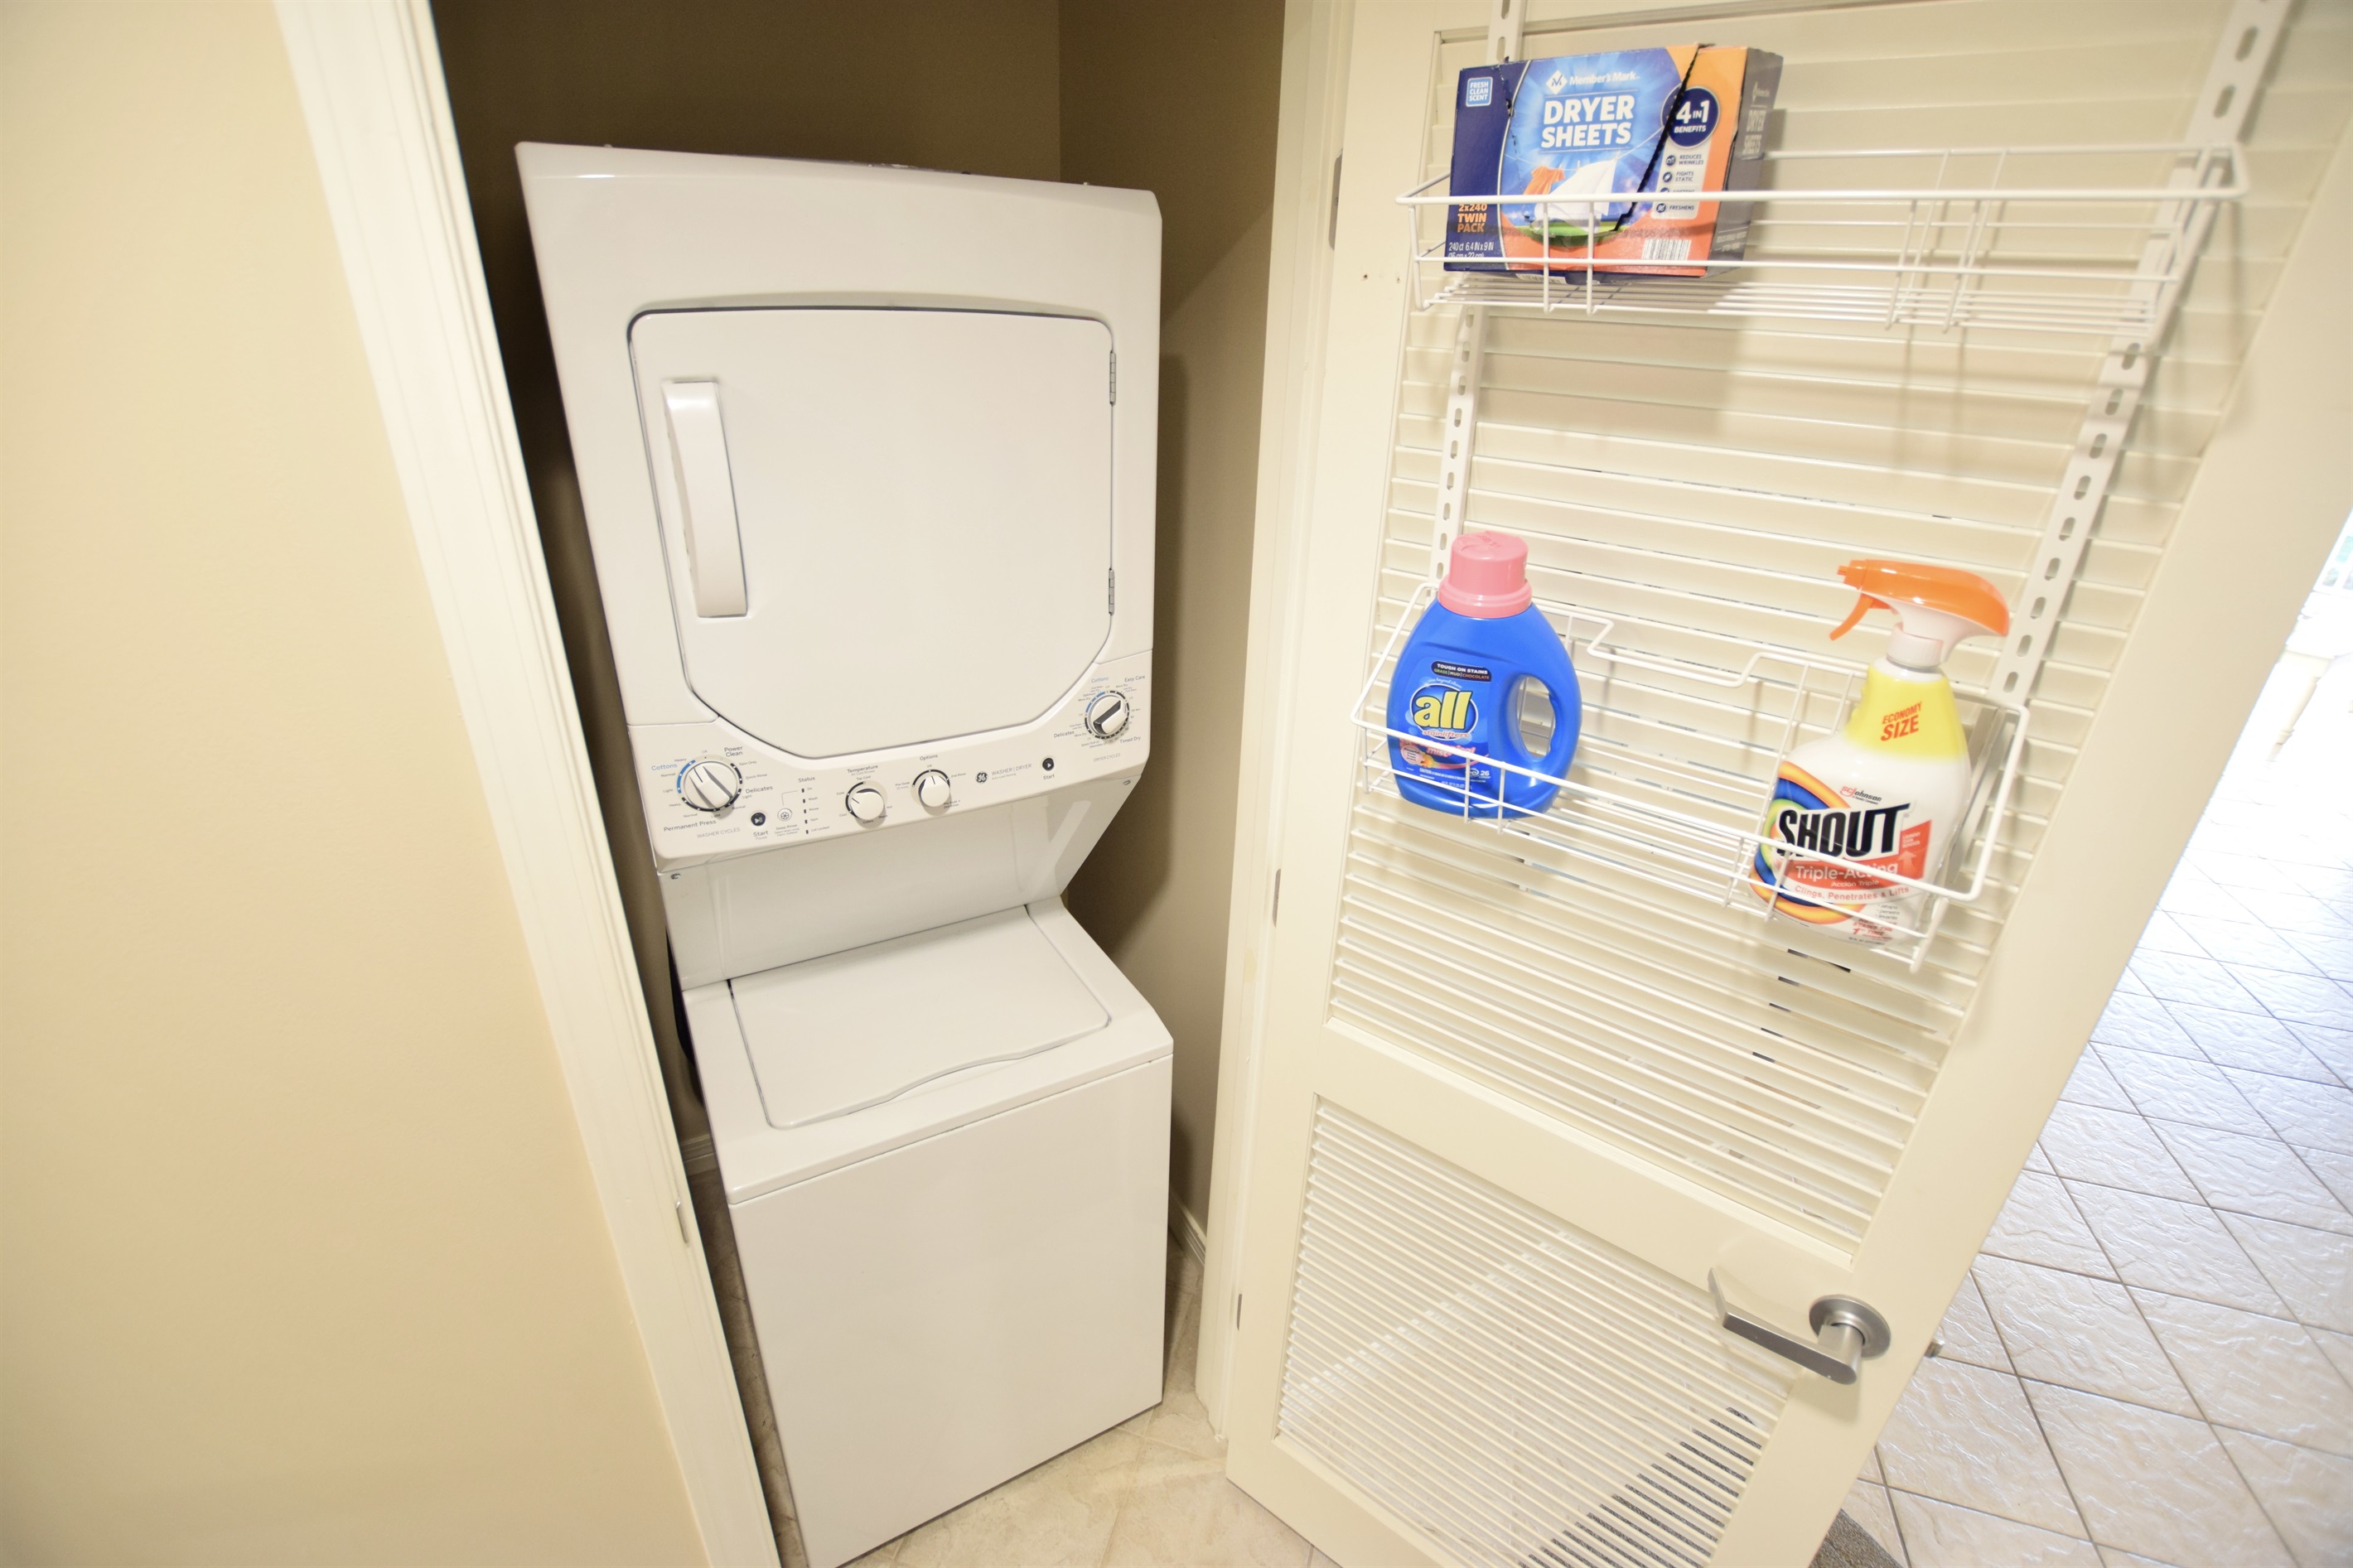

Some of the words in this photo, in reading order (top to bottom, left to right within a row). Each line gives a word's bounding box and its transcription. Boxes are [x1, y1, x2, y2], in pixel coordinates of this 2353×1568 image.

[1569, 73, 1611, 85] Member's
[1613, 71, 1636, 81] Mark
[1544, 95, 1636, 124] DRYER
[1676, 101, 1692, 124] 4
[1693, 110, 1702, 118] IN
[1700, 100, 1710, 123] 1
[1541, 123, 1631, 148] SHEETS
[1674, 125, 1707, 133] BENEFITS
[1458, 203, 1487, 212] 2x240
[1457, 213, 1487, 223] TWIN
[1457, 223, 1486, 233] PACK
[1413, 691, 1472, 730] all
[1882, 702, 1922, 725] ECONOMY
[1423, 730, 1469, 739] stainlifters
[1881, 714, 1919, 741] SIZE
[848, 765, 878, 774] Temperature
[992, 767, 1012, 775] WASHER
[746, 785, 773, 794] Delicates
[664, 823, 698, 832] Permanent
[1776, 803, 1911, 858] SHOUT
[1795, 863, 1898, 882] Triple-Acing
[1828, 892, 1877, 900] Penetrates
[1889, 886, 1910, 896] Lifts
